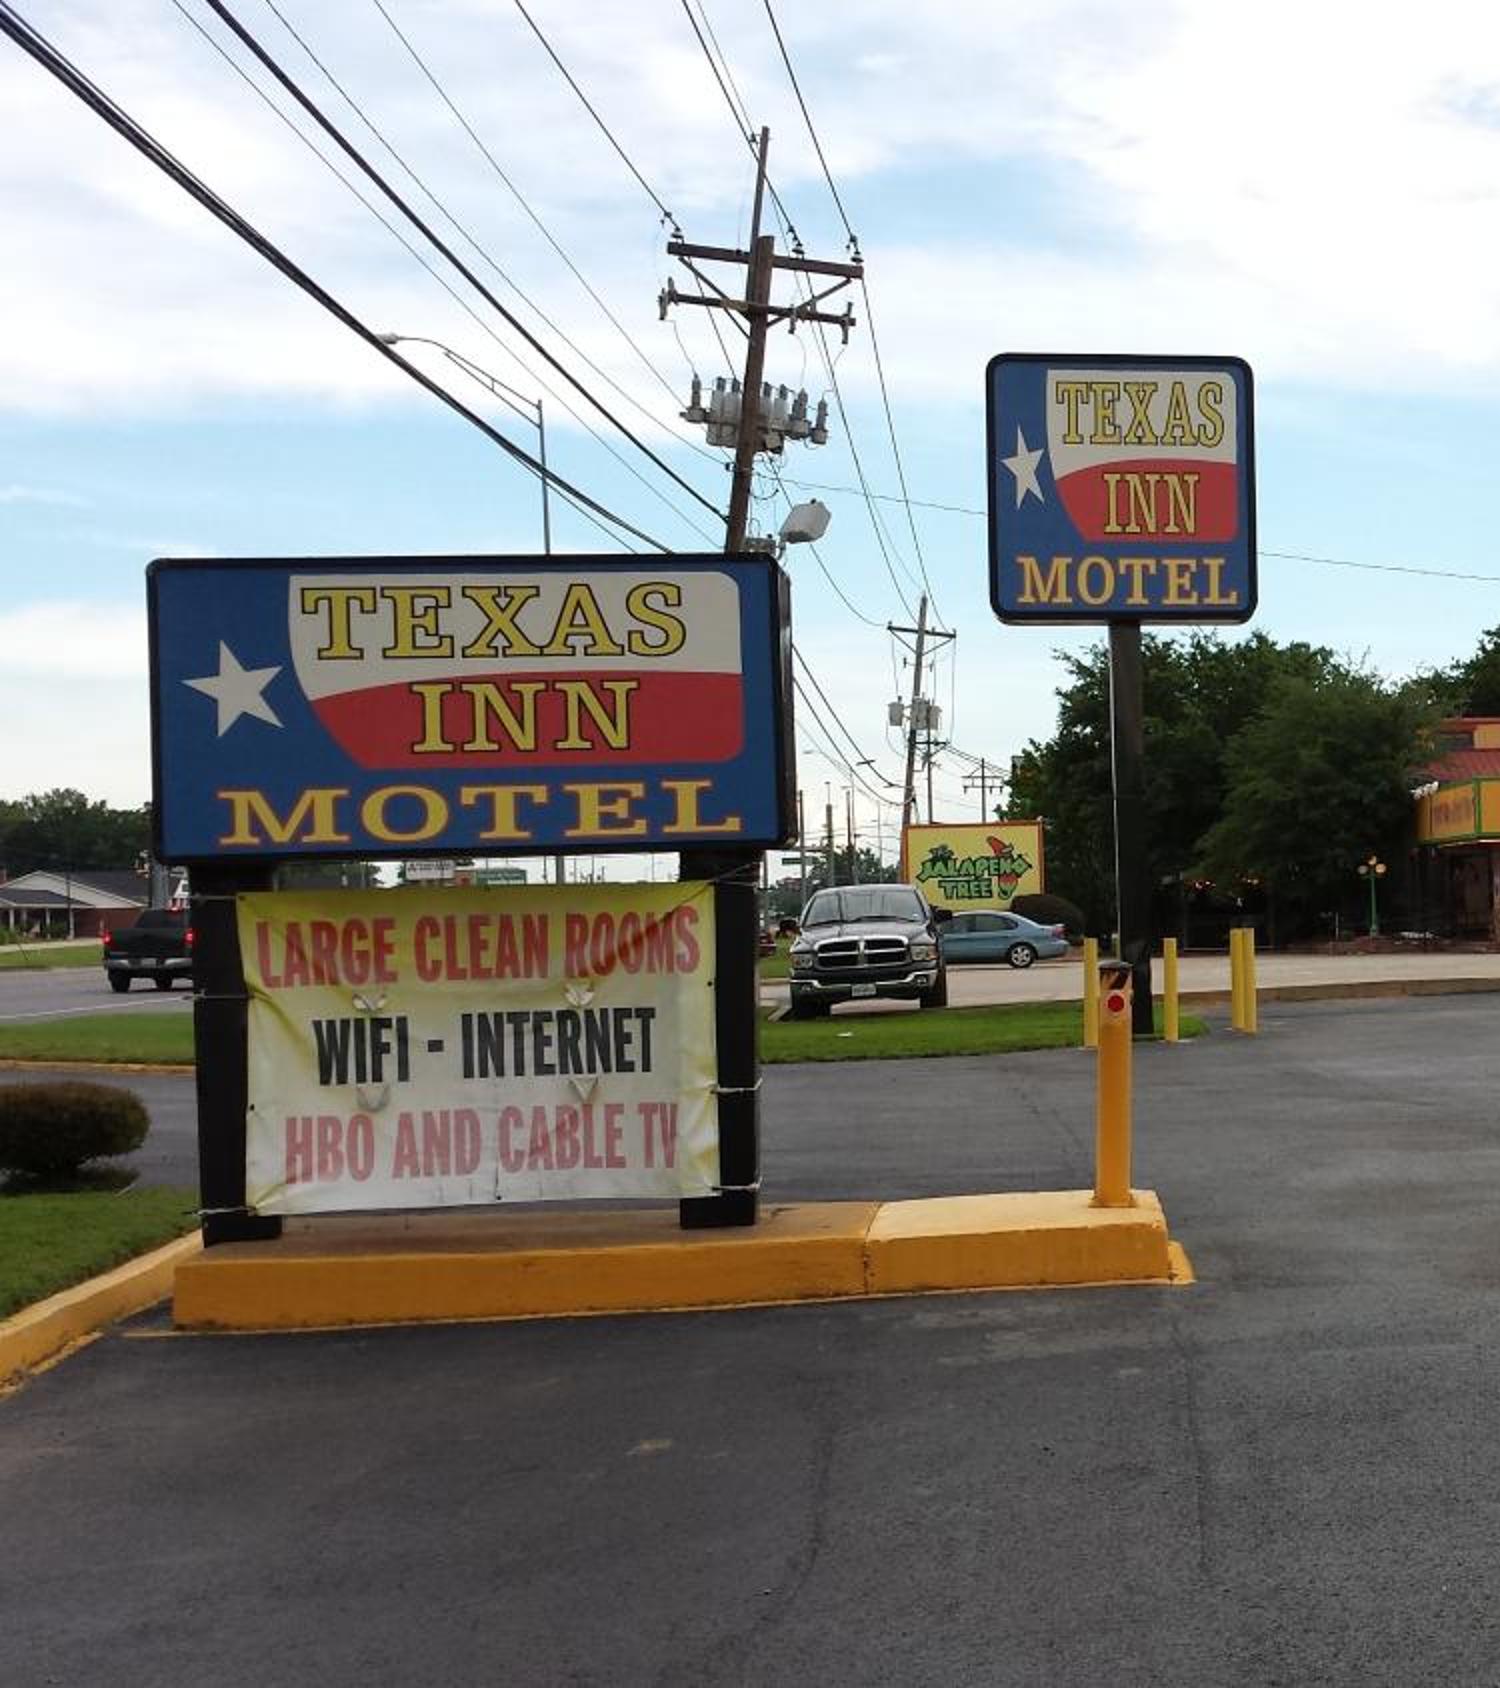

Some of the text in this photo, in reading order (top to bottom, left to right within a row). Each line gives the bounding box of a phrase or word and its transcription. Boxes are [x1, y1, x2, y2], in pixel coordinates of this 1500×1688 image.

[1055, 381, 1225, 448] TEXAS
[1103, 472, 1200, 534] INN
[1015, 556, 1239, 605] MOTEL
[300, 582, 687, 660] TEXAS
[408, 679, 639, 754] INN
[216, 780, 742, 846] MOTEL
[938, 878, 993, 900] TREE
[255, 905, 701, 988] LARGE CLEAN ROOMS
[313, 1015, 409, 1085] WIFI
[461, 1007, 656, 1078] INTERNET
[285, 1102, 678, 1184] HBO AND CABLE TV
